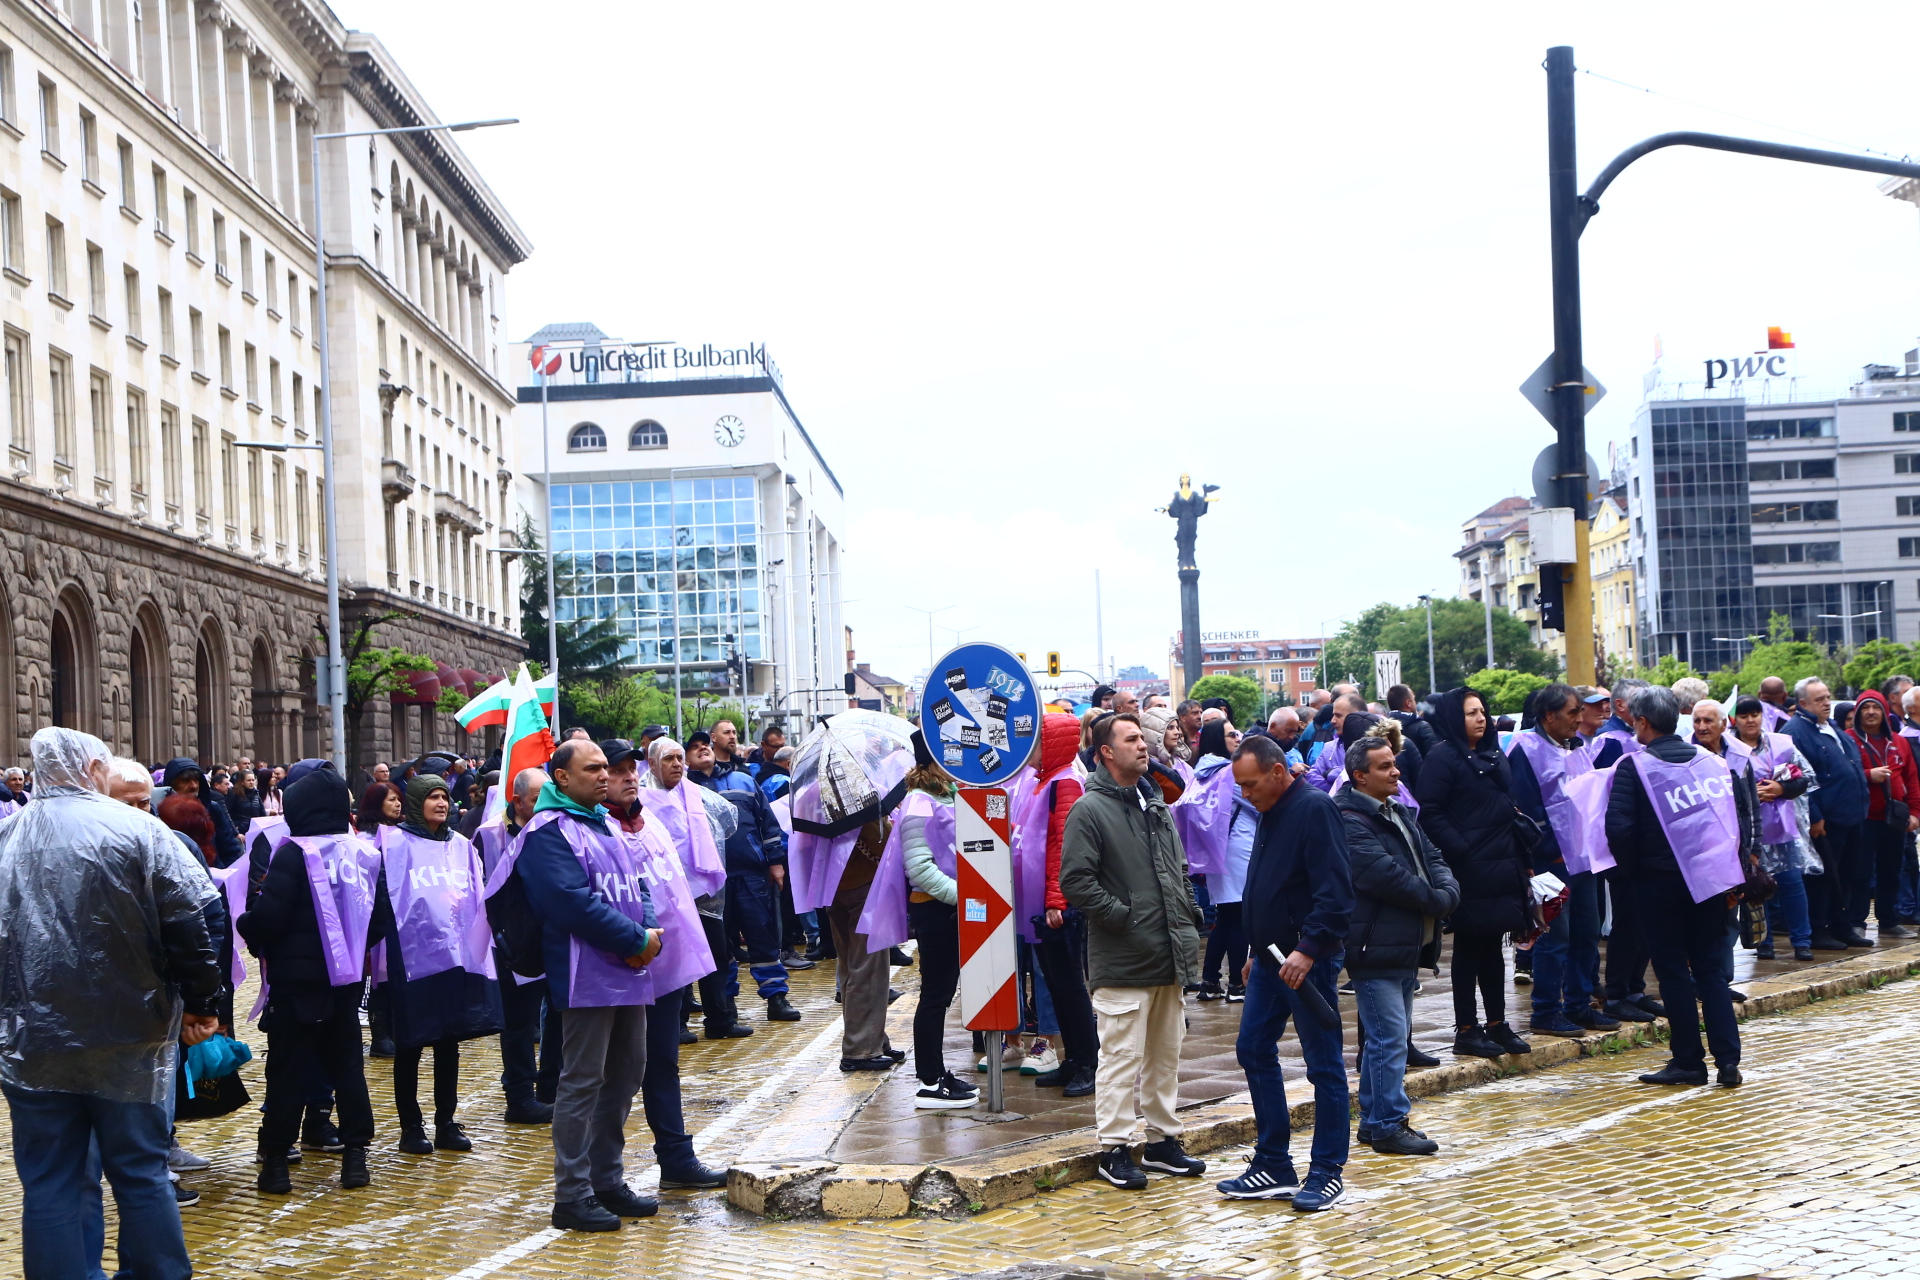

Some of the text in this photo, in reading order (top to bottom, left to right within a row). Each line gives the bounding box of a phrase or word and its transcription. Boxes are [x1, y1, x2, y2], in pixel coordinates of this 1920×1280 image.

[570, 342, 765, 373] UniCredit Bulbank
[1703, 355, 1786, 389] pwc
[1201, 630, 1260, 641] SCHENKER
[961, 734, 980, 743] SOFIA
[325, 859, 368, 893] НСБ
[967, 910, 985, 919] ultra
